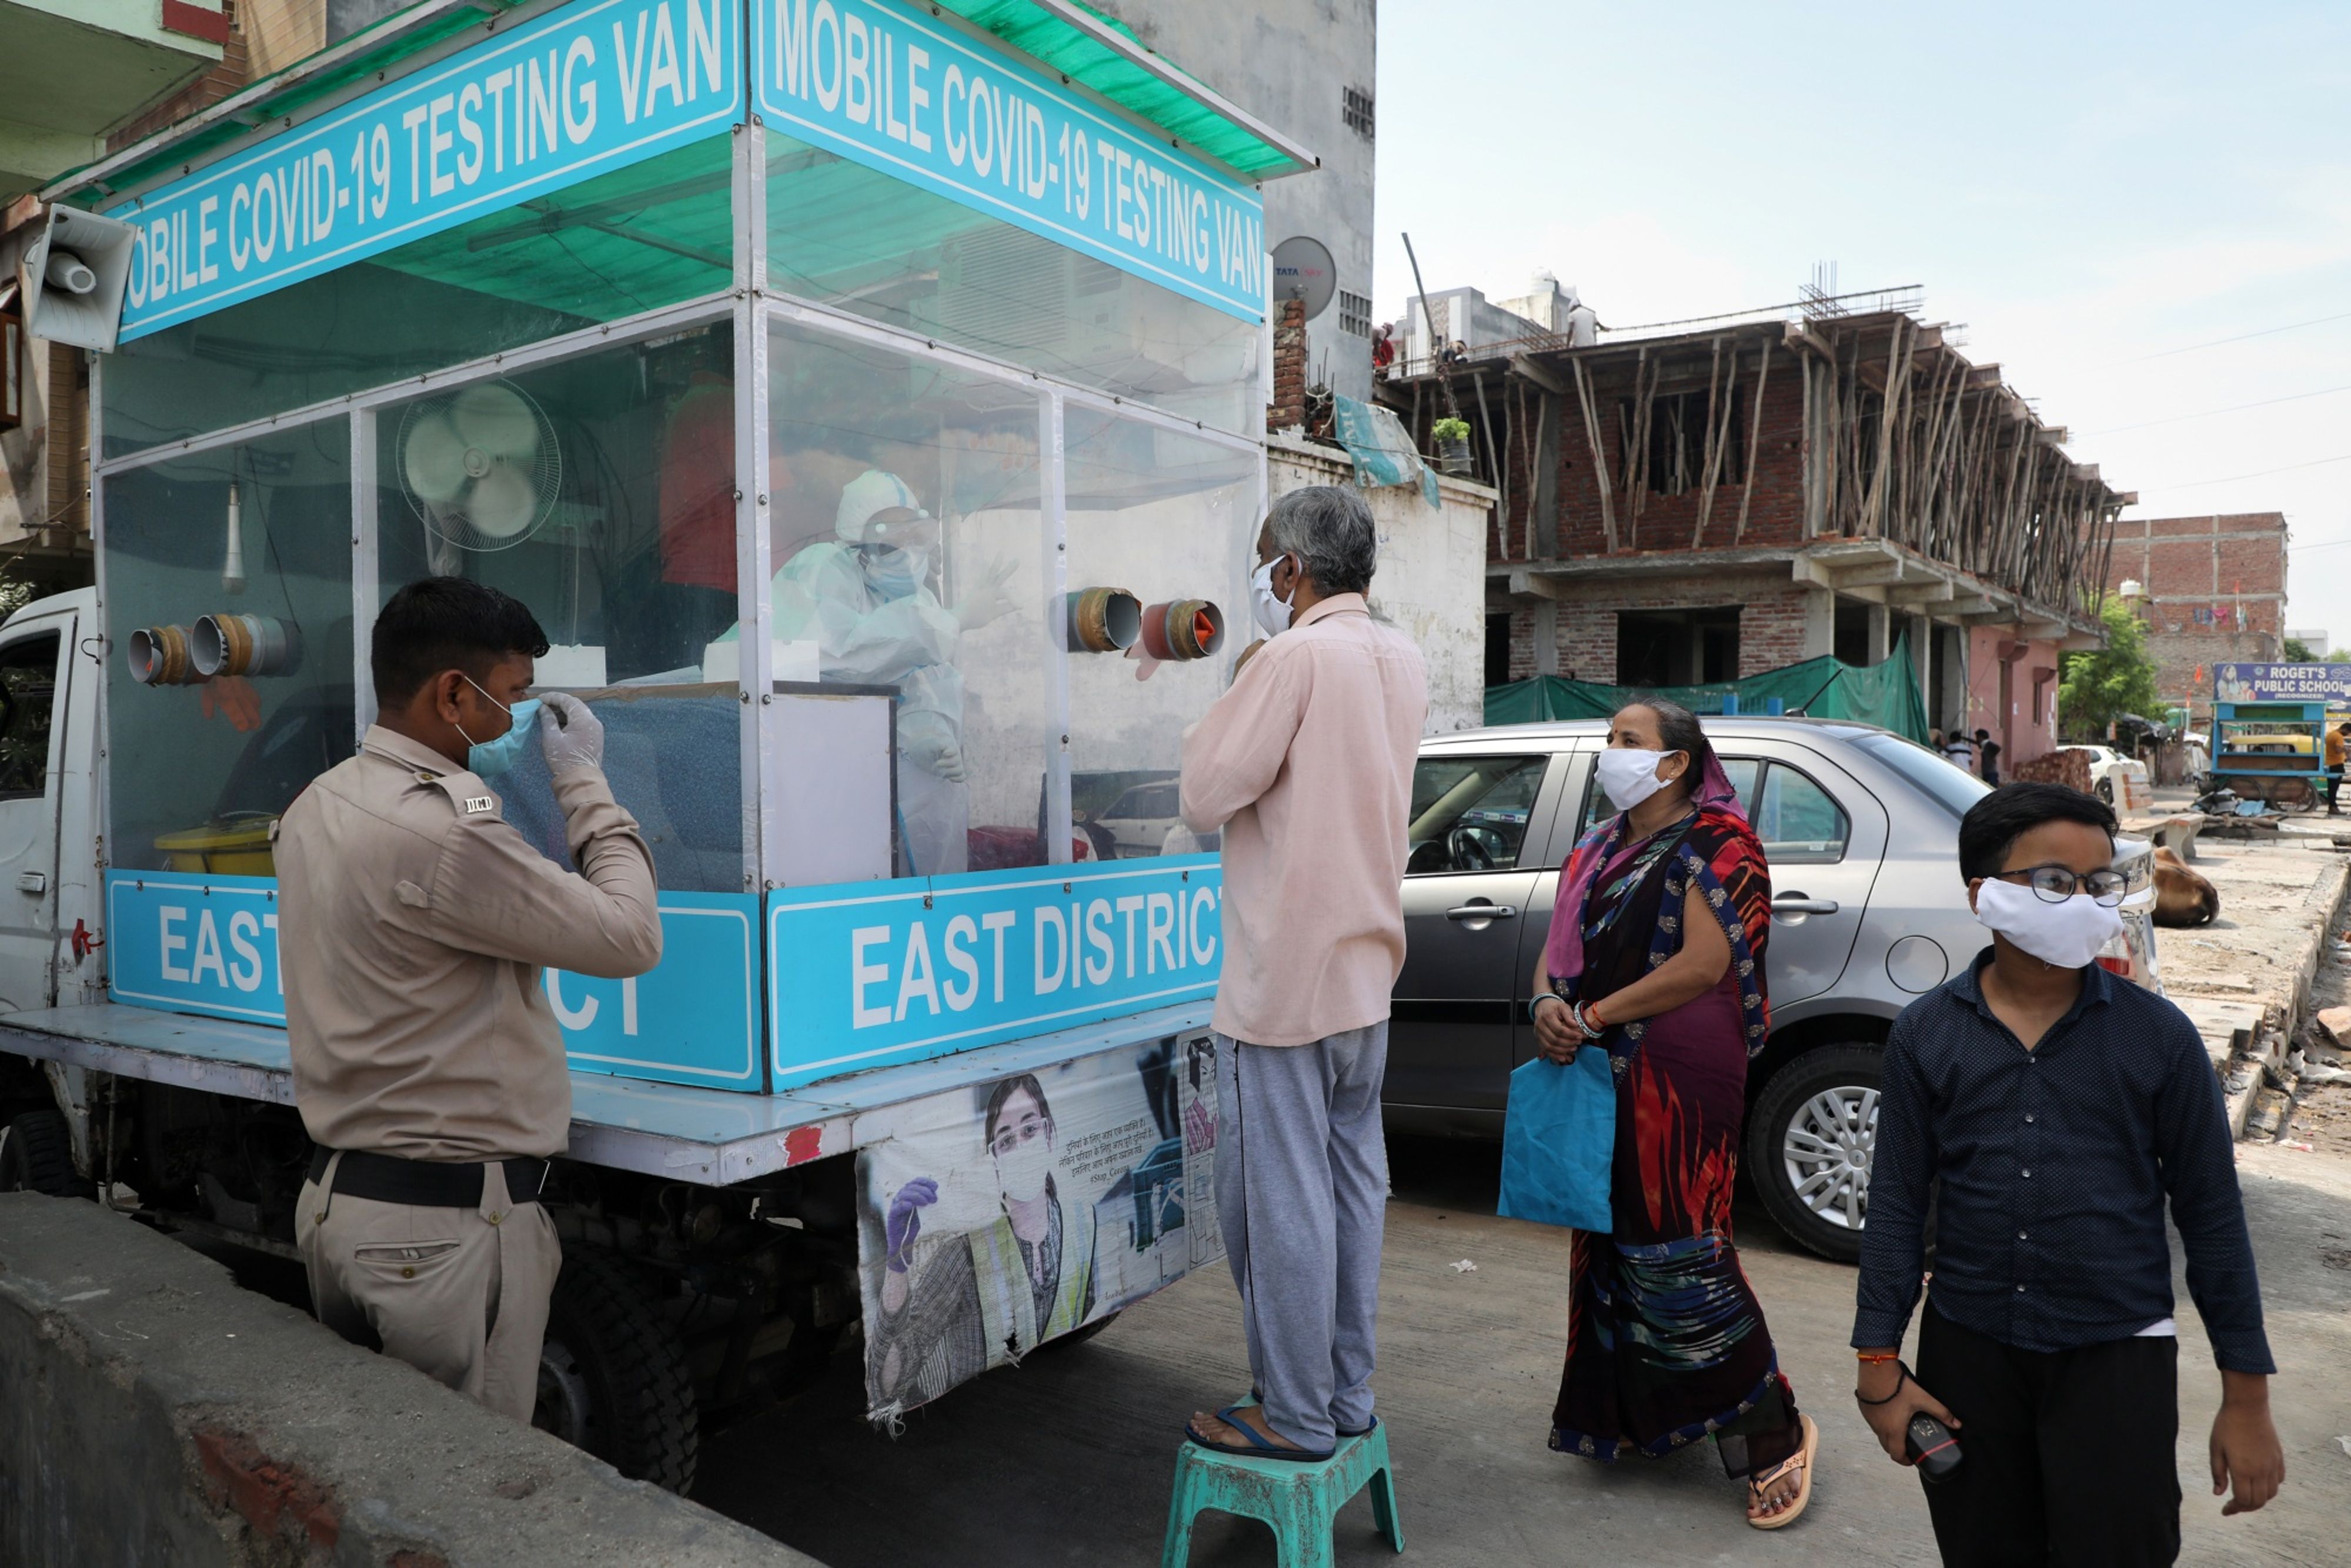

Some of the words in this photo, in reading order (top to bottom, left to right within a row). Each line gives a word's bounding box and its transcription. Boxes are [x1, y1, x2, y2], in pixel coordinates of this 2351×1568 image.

[122, 195, 218, 312] OBILE
[229, 123, 391, 272] COVID-19
[403, 35, 597, 205] TESTING
[612, 0, 722, 125] VAN
[776, 0, 931, 153] MOBILE
[943, 63, 1089, 222] COVID-19
[1097, 139, 1210, 274] TESTING
[1215, 199, 1261, 297] VAN
[1275, 268, 1298, 276] TATA
[2254, 680, 2296, 692] PUBLIC
[2270, 667, 2326, 678] ROGET'S
[852, 910, 1016, 1029] EAST
[1034, 886, 1222, 995] DISTRIC
